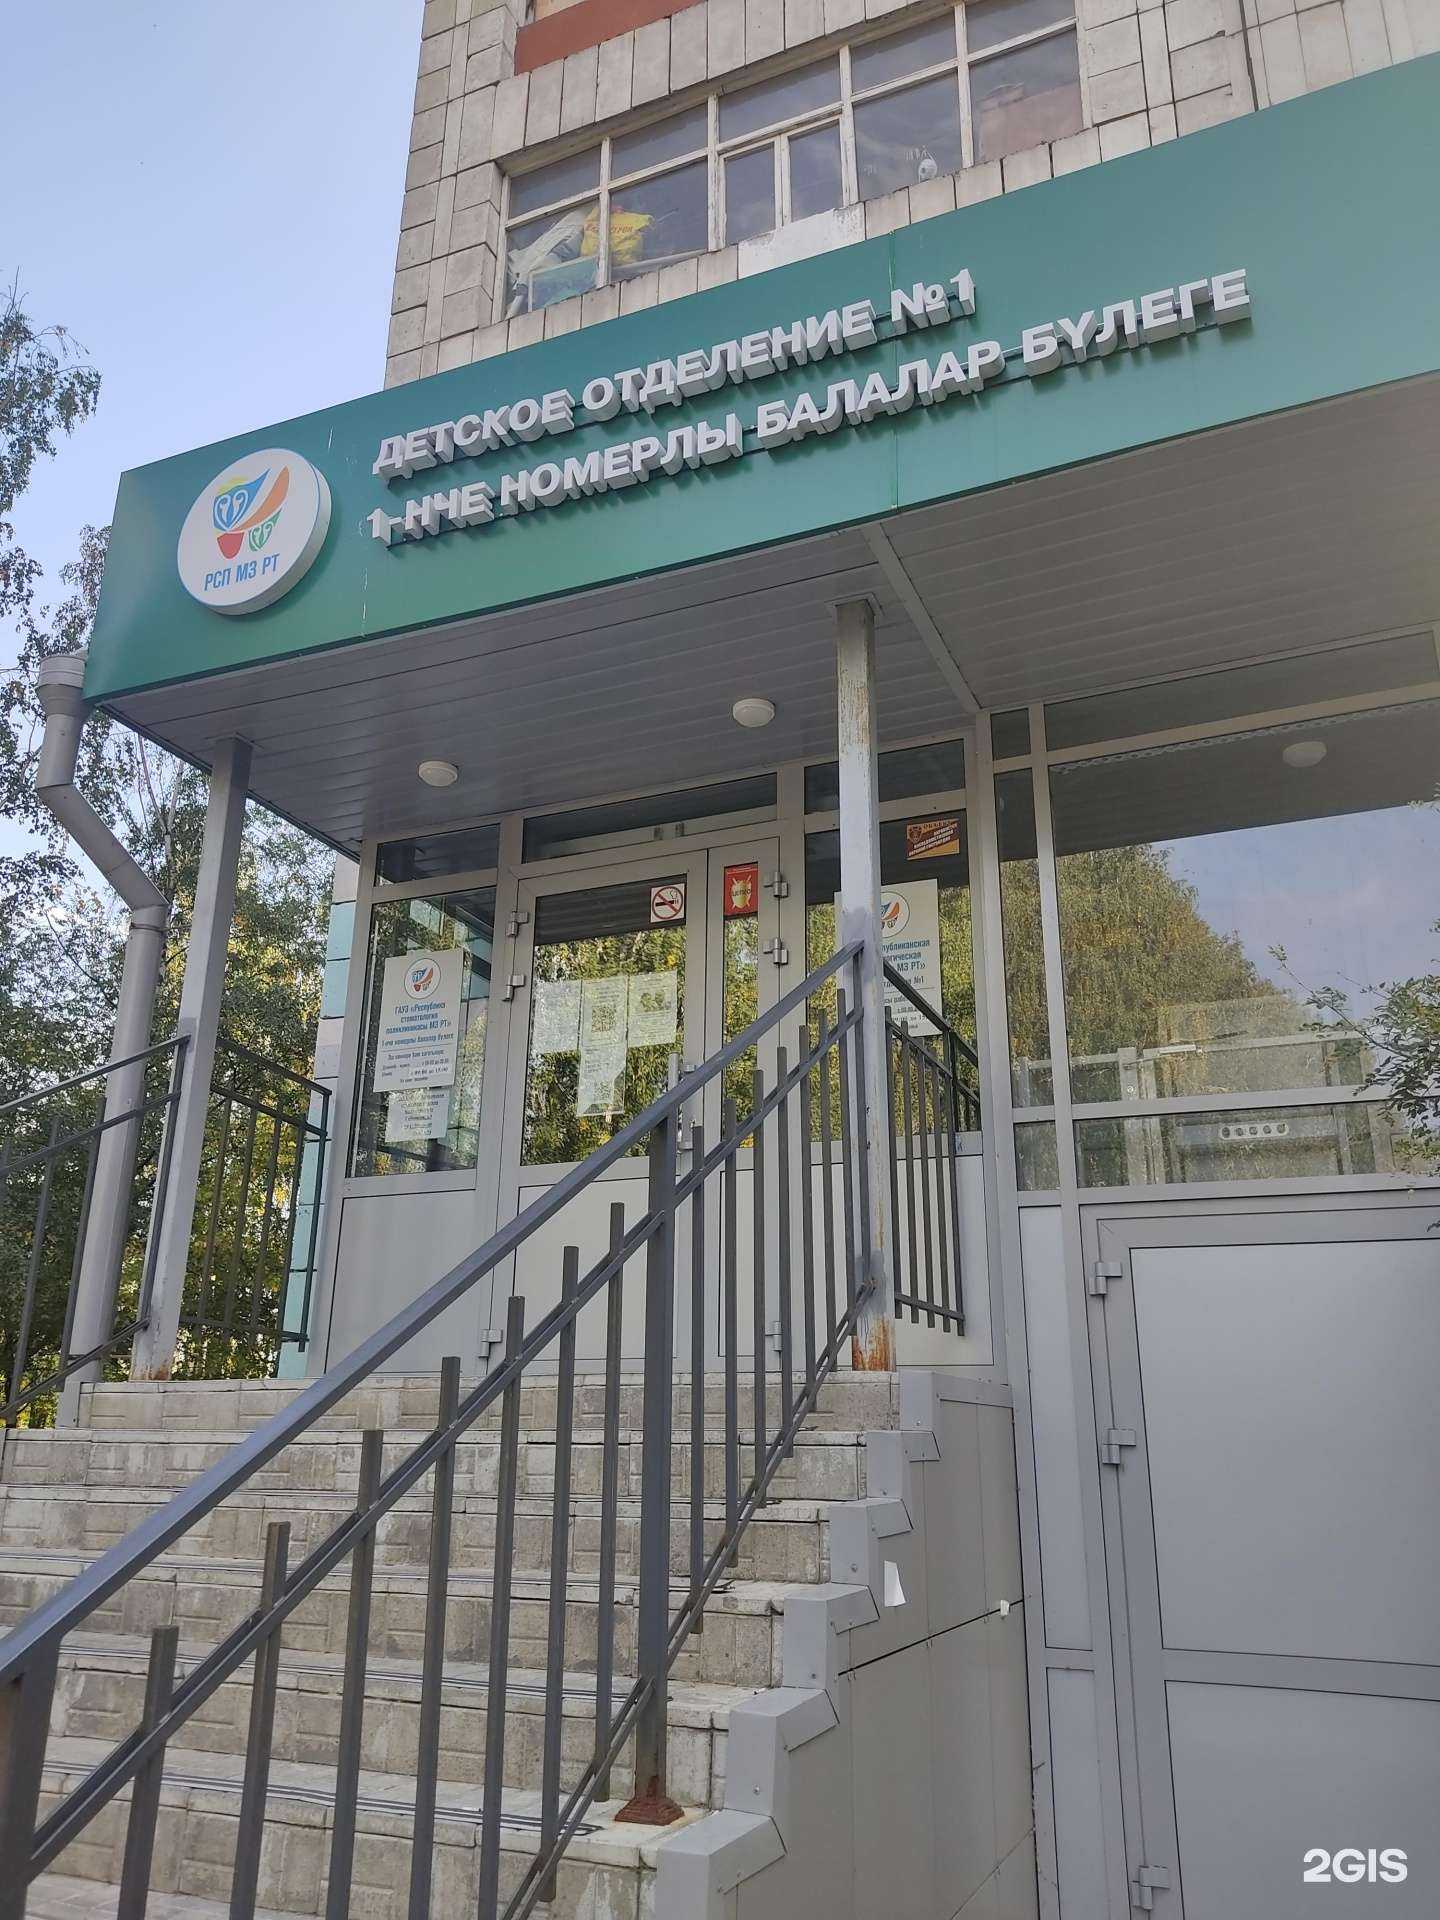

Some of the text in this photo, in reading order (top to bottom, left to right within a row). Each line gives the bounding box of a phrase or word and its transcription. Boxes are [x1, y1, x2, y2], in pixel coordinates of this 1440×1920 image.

[367, 269, 1251, 543] 1-НЧЕ НОМЕРЛЫ БАЛАЛАР БҮЛЕГЕ
[373, 268, 975, 479] ДЕТСКОЕ ОТДЕЛЕНИЕ №1
[204, 553, 280, 591] РСП МЗ РТ
[897, 962, 909, 972] МЗ
